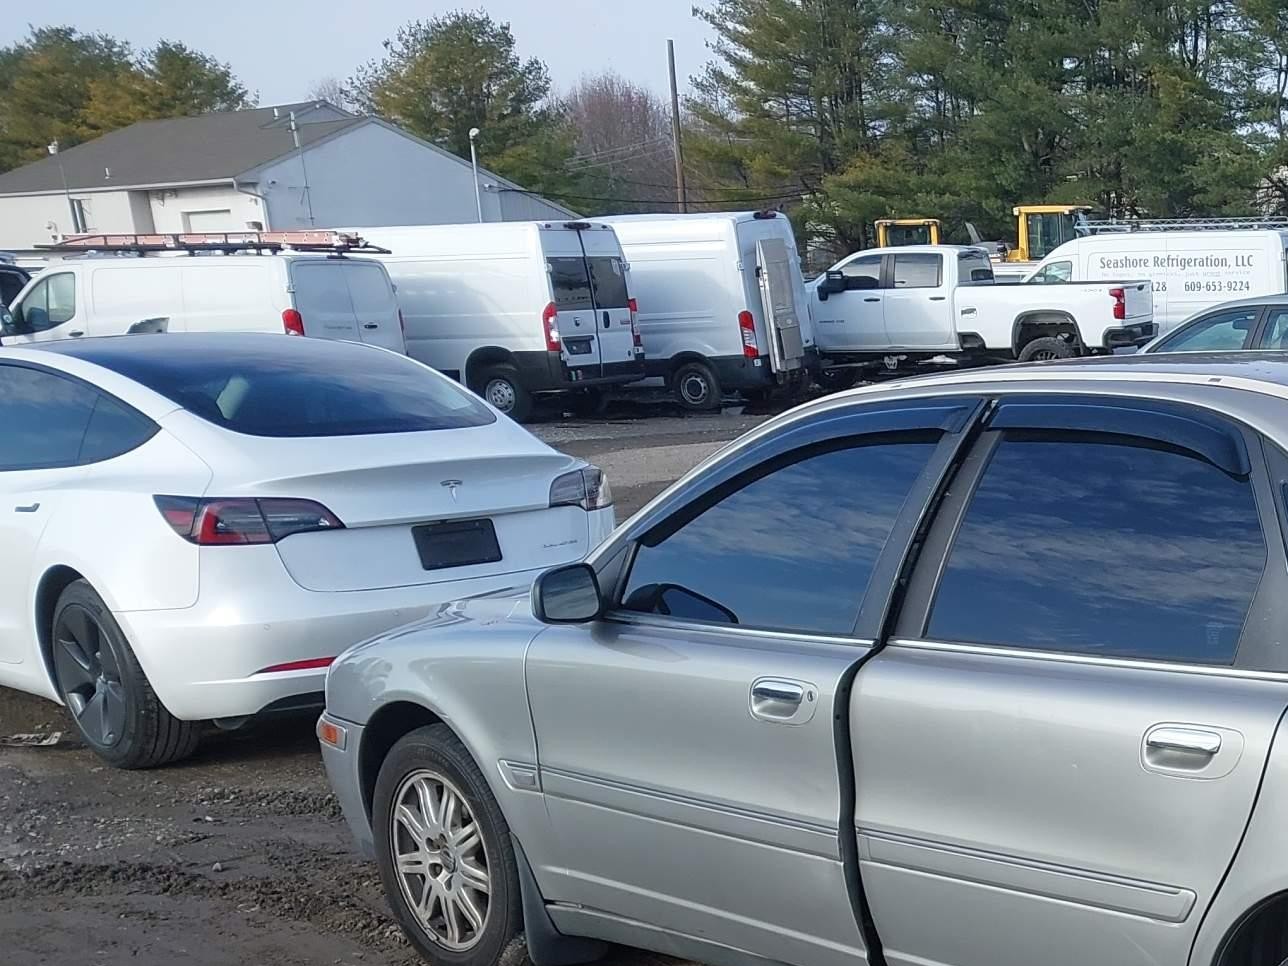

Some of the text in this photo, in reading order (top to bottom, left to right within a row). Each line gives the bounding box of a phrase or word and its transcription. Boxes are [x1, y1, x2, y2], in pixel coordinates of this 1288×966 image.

[1099, 254, 1253, 271] Seashore Refrigeration, LLC
[1184, 281, 1250, 292] 609-653-9224
